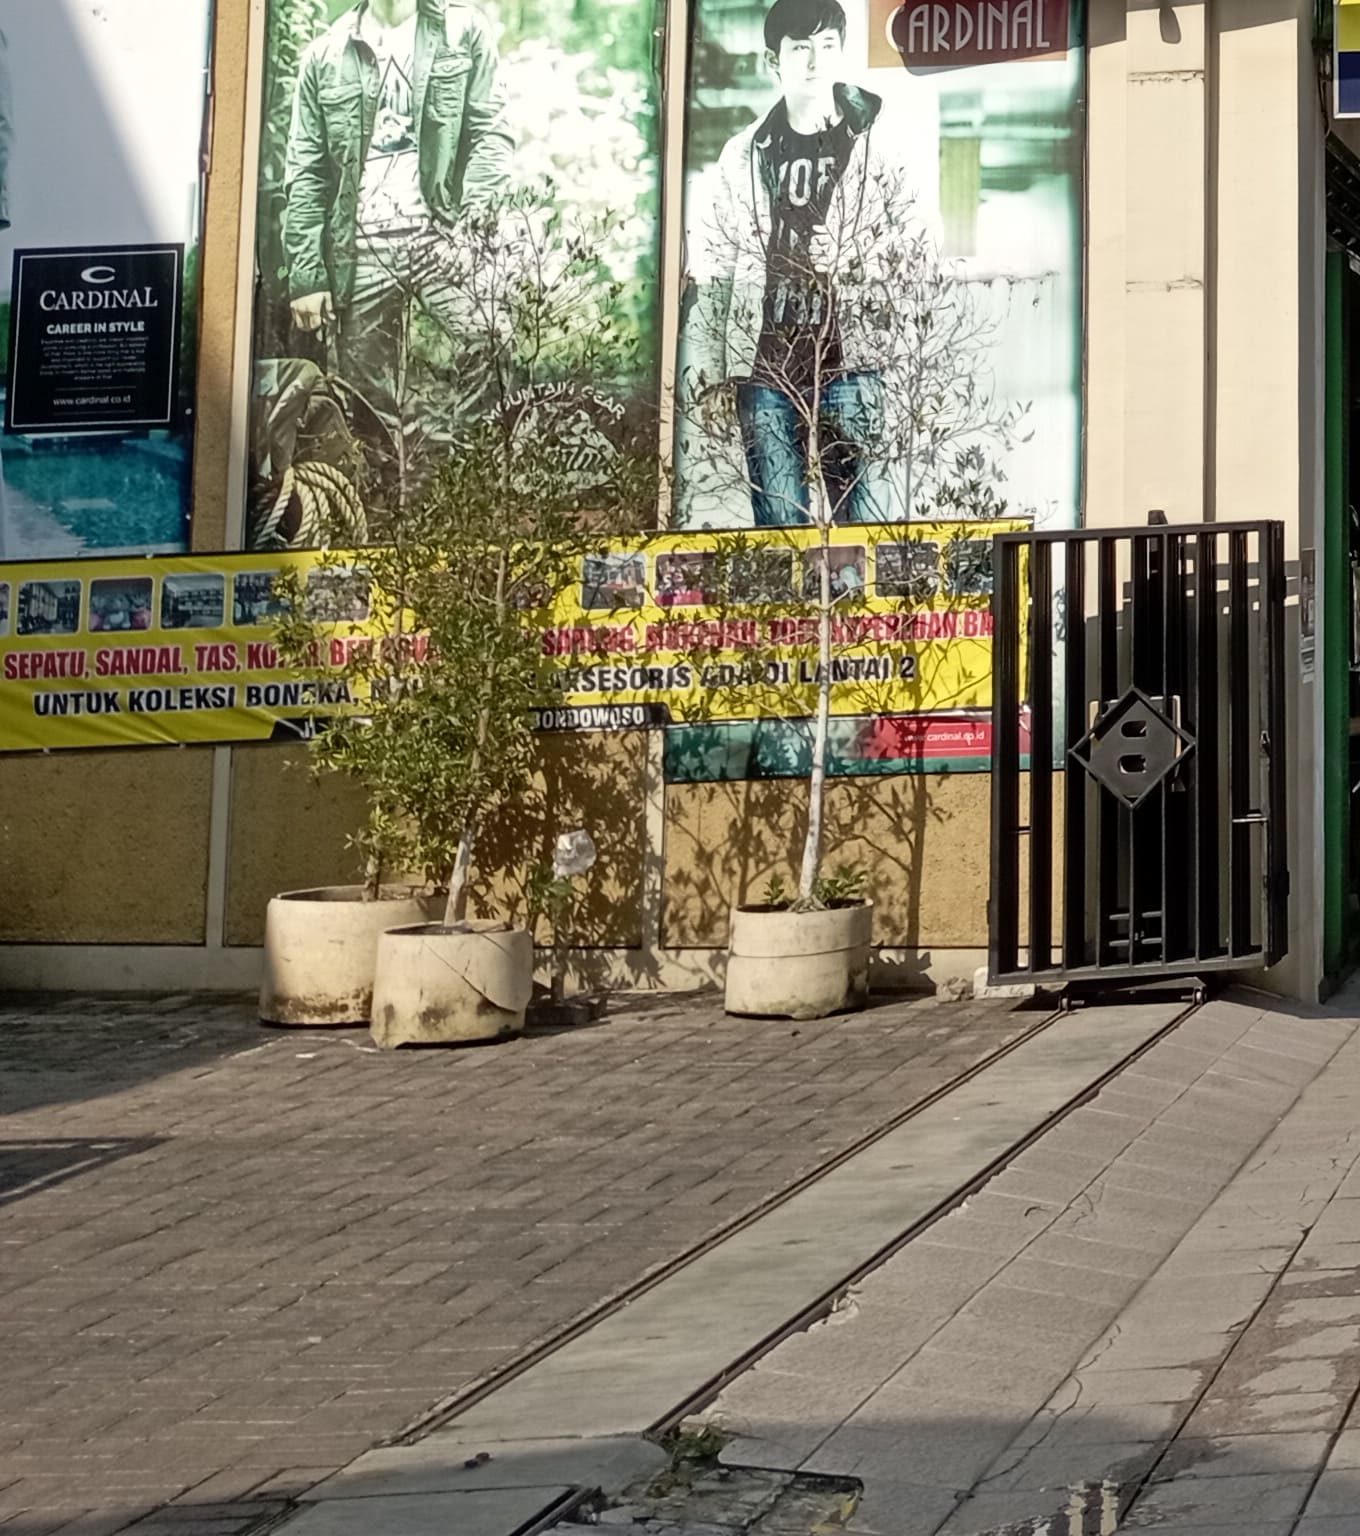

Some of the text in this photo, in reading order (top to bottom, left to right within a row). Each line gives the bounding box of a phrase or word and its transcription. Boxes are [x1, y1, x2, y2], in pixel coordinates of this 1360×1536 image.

[40, 287, 158, 311] CARDINAL
[46, 320, 145, 335] CAREER IN STYLE
[5, 650, 89, 679] SEPATU,
[96, 647, 188, 675] SANDAL,
[195, 644, 241, 672] TAS,
[34, 691, 120, 715] UNTUK
[128, 686, 235, 712] KOLEKSI
[901, 656, 914, 679] 2
